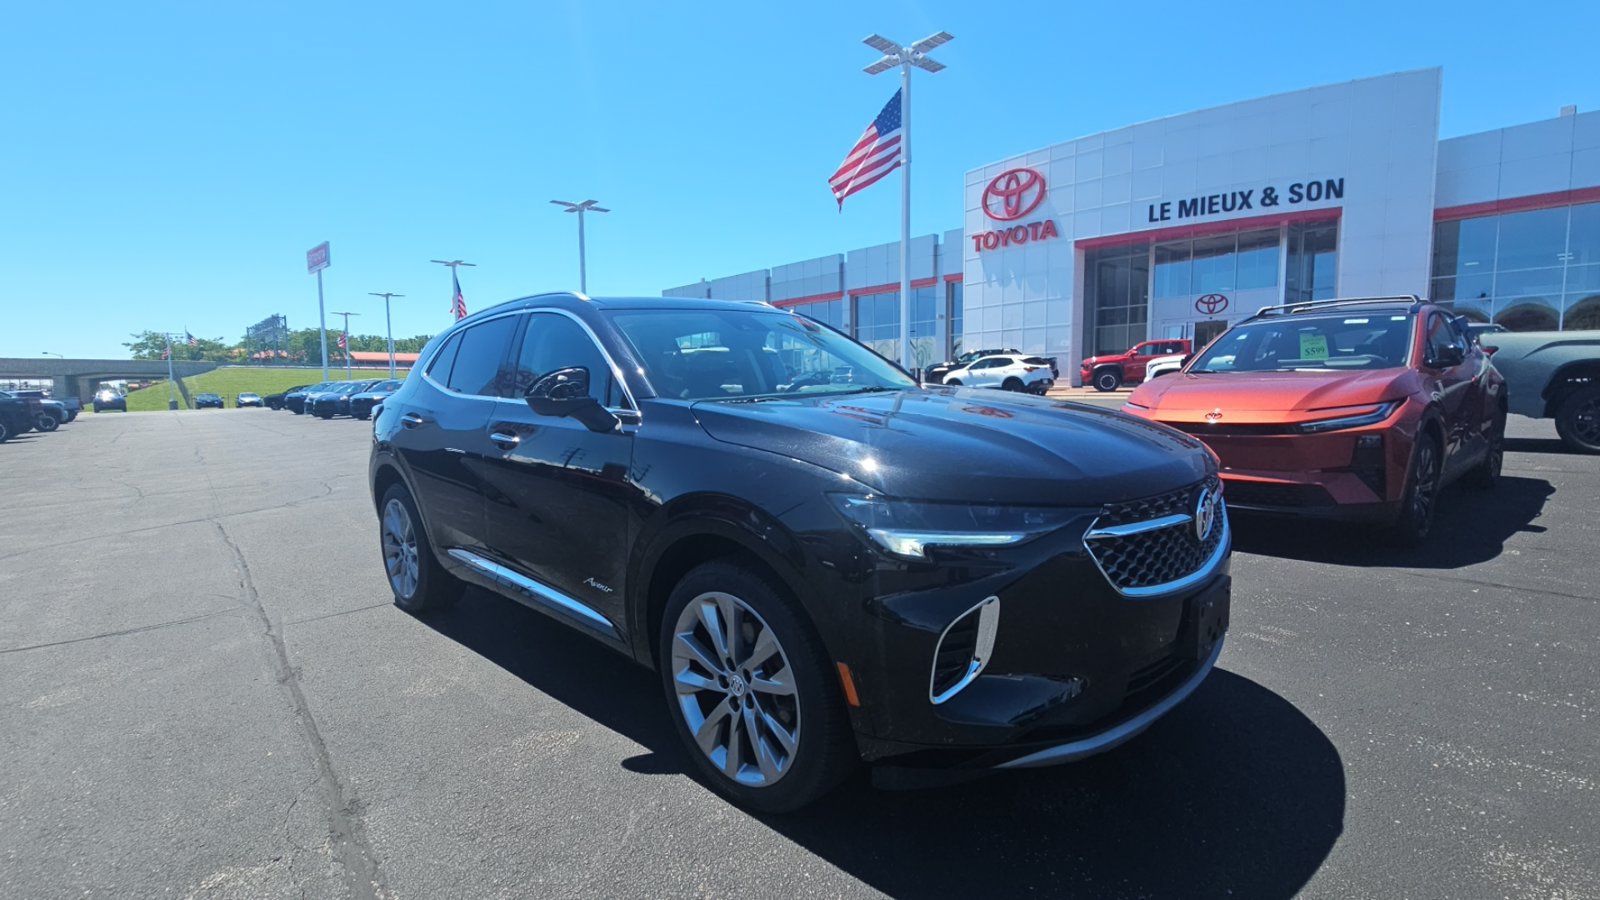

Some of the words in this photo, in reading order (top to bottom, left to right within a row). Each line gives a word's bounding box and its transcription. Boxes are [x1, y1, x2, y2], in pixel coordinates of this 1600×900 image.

[1148, 202, 1171, 223] LE
[1178, 189, 1254, 219] MIEUX
[1260, 186, 1280, 207] &
[1288, 178, 1345, 204] SON
[971, 219, 1058, 253] TOYOTA
[583, 577, 613, 593] Avenir
